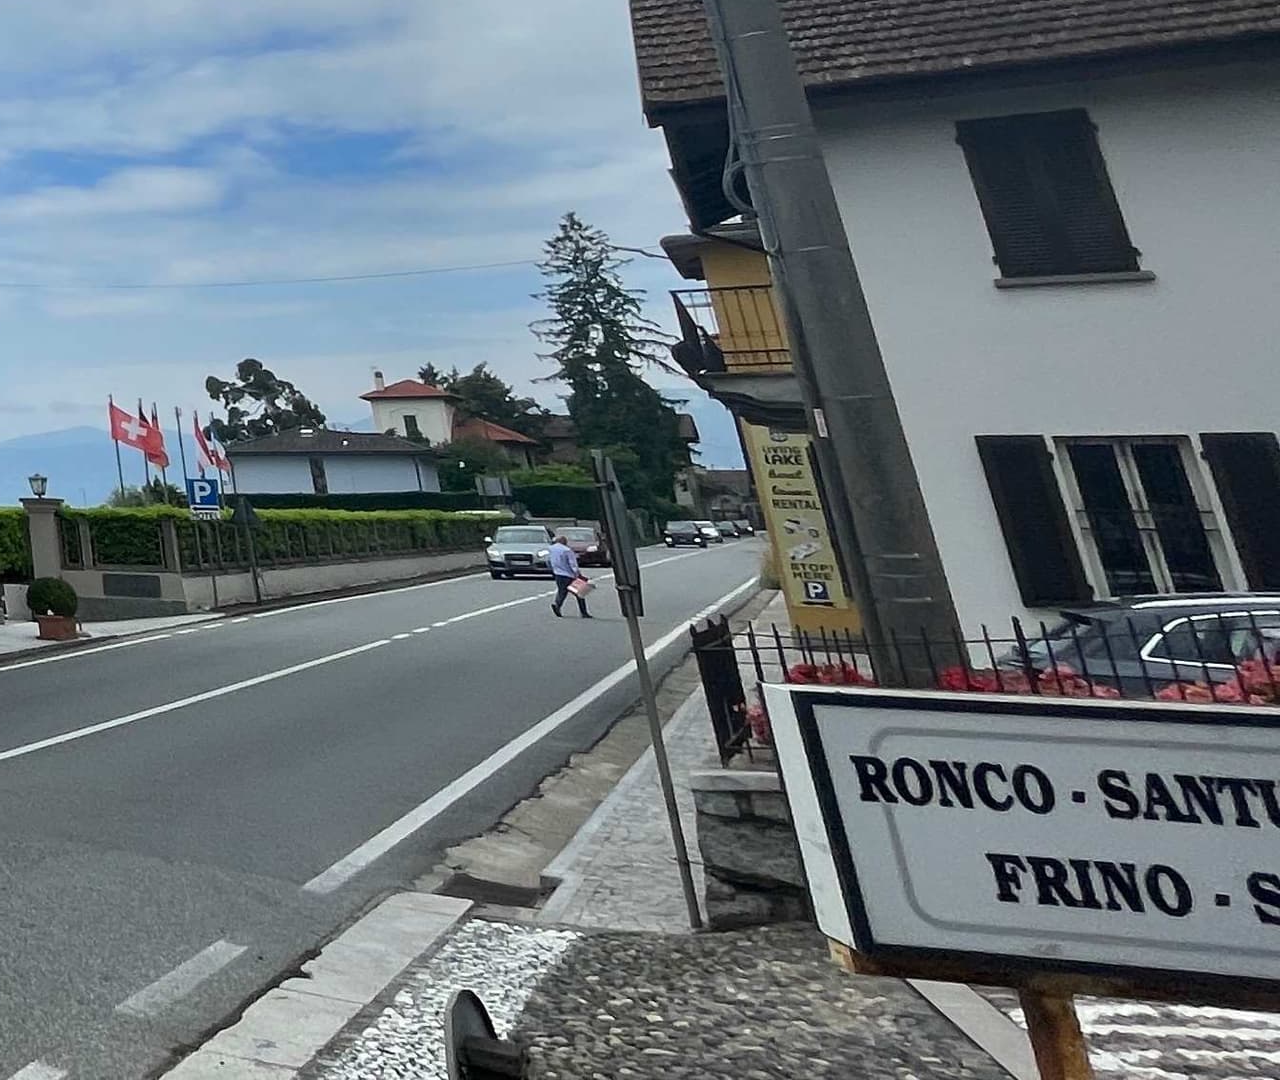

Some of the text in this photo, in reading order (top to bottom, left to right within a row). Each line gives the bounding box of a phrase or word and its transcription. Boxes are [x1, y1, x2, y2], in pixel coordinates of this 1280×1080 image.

[764, 454, 805, 466] LAKE
[193, 481, 212, 504] P
[772, 499, 821, 511] RENTAL
[807, 582, 824, 598] P
[849, 755, 1056, 815] RONCO
[985, 853, 1194, 918] FRINO
